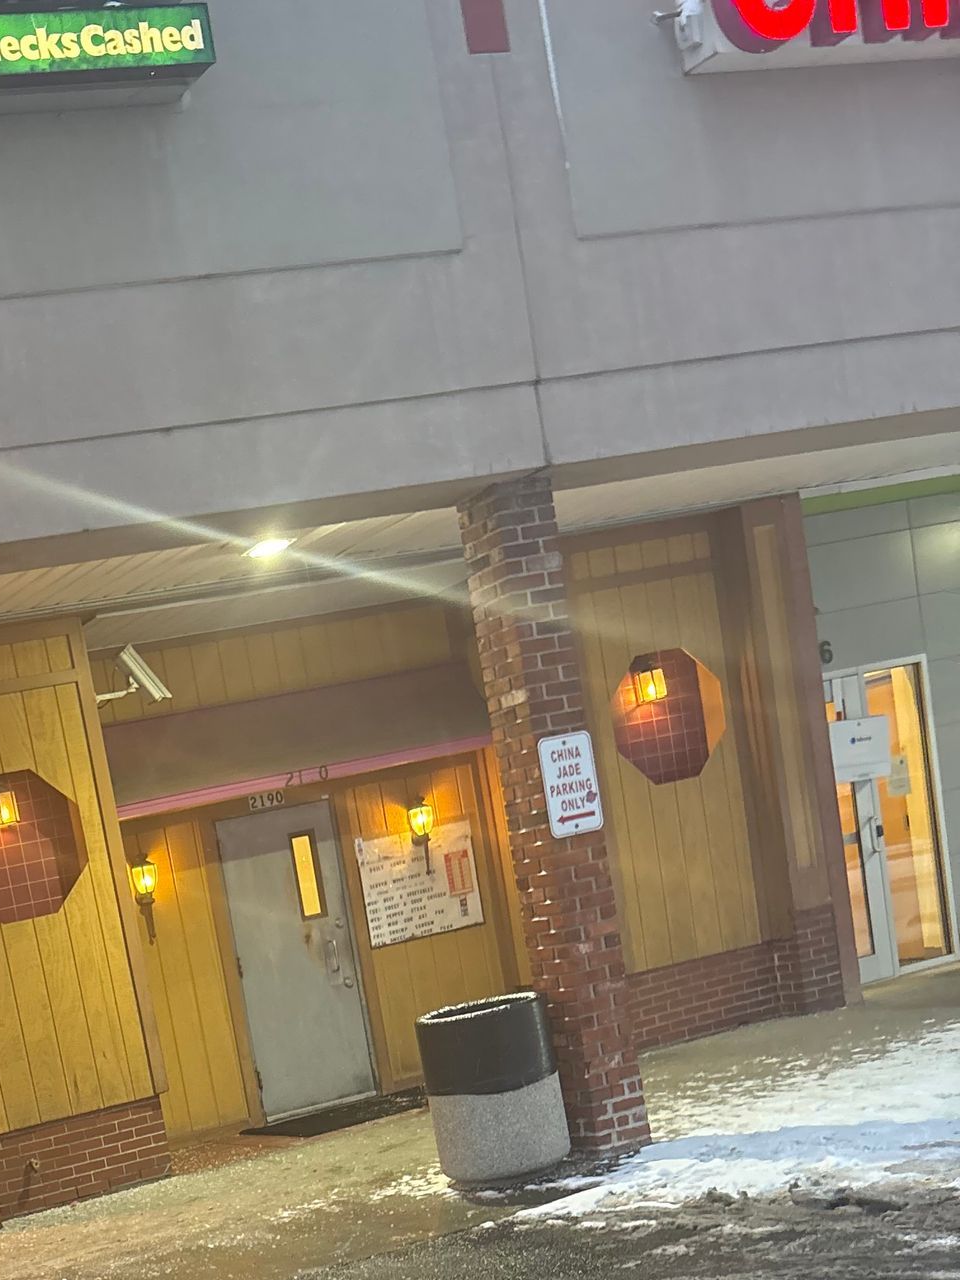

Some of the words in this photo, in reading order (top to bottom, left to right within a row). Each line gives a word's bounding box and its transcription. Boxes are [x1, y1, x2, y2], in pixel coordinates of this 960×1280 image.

[550, 746, 582, 763] CHINA
[556, 763, 582, 779] JADE
[550, 778, 592, 798] PARKING
[249, 790, 283, 810] 2190
[561, 796, 586, 812] ONLY
